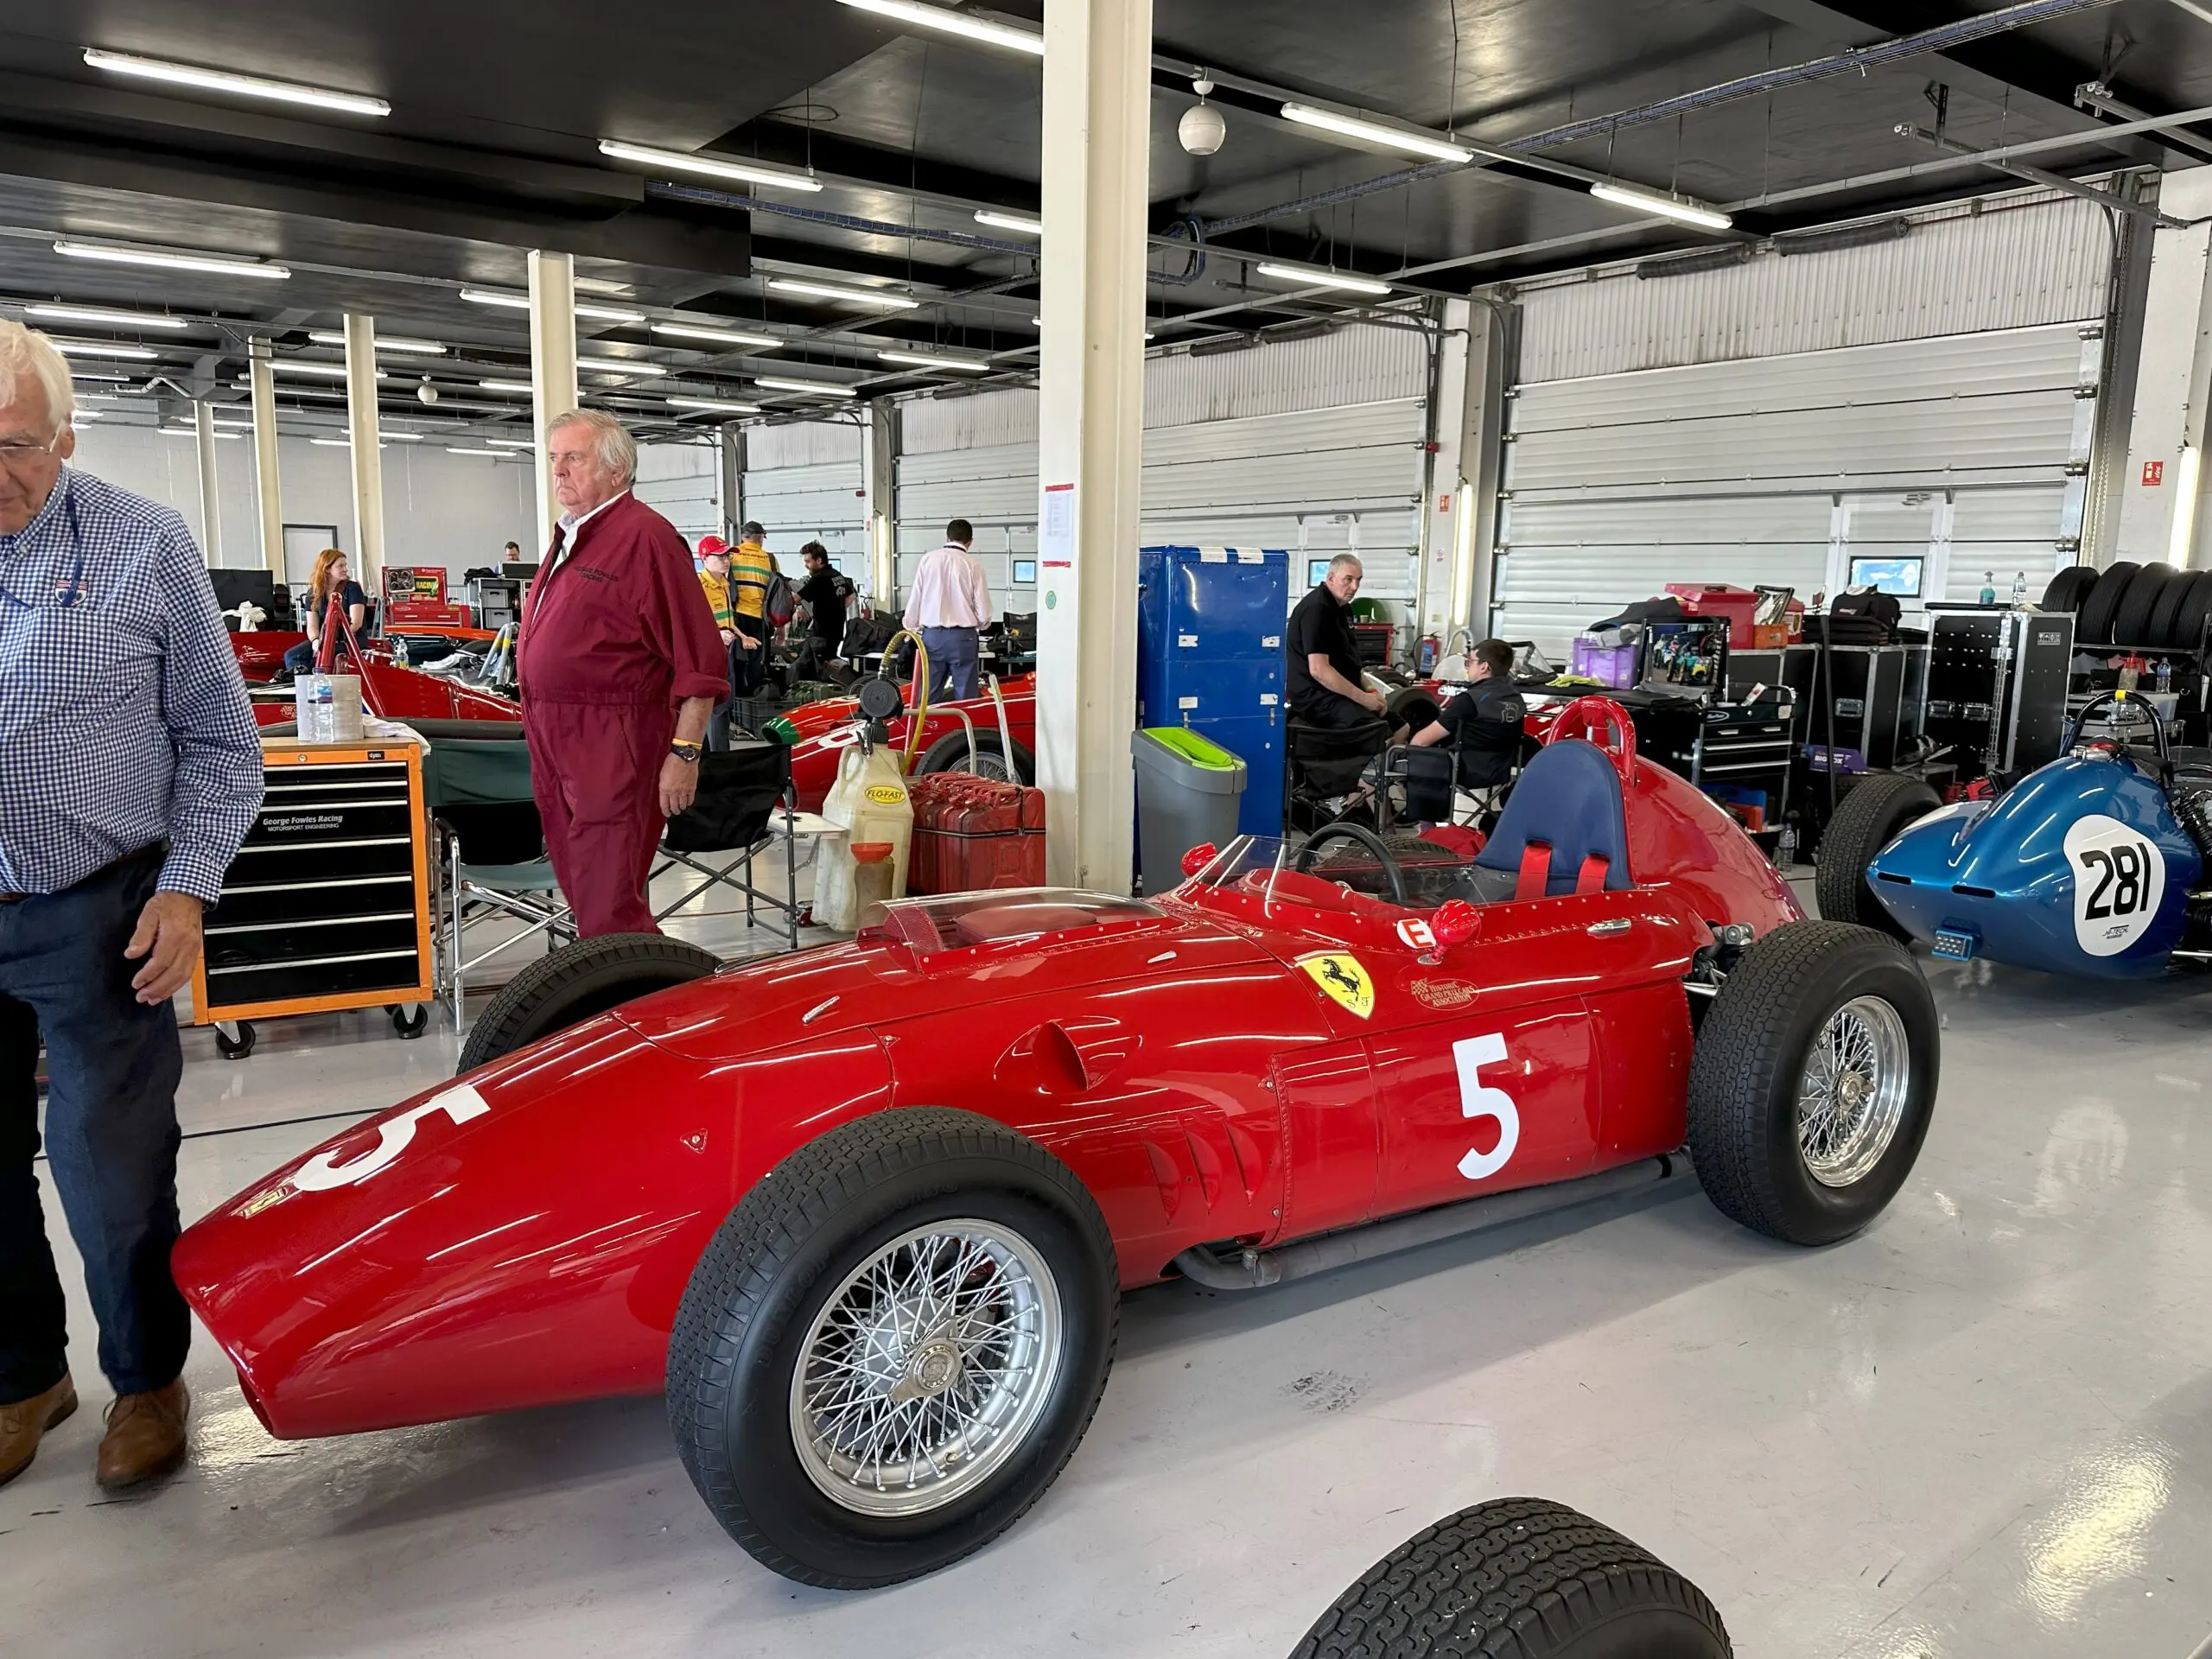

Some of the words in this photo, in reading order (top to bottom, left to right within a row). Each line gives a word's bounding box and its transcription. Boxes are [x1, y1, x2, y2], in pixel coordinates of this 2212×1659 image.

[263, 817, 289, 826] George
[291, 816, 316, 824] Fowles
[318, 815, 343, 823] Racing
[2080, 842, 2152, 920] 281
[1402, 918, 1434, 948] E
[1421, 991, 1443, 1001] GRAND
[1459, 985, 1475, 995] CARS
[1428, 981, 1459, 992] HISTORIC
[1433, 994, 1472, 1007] ASSOCIATION
[1452, 1032, 1520, 1179] 5
[294, 1084, 491, 1192] 5
